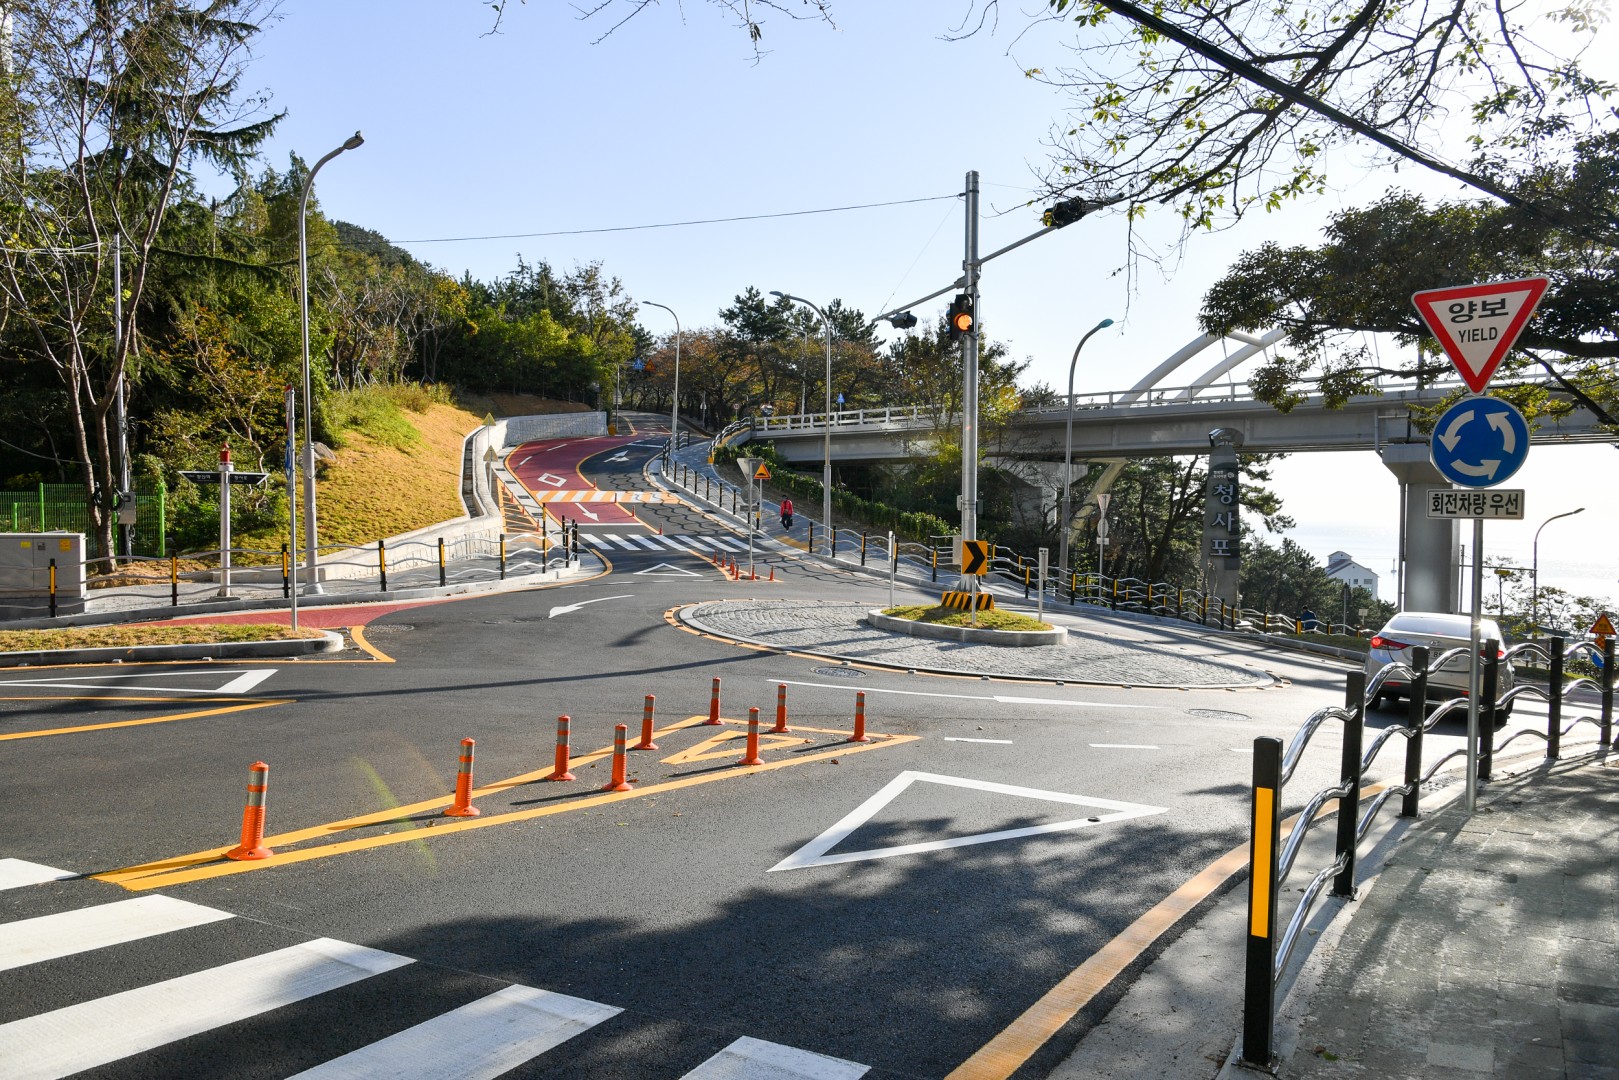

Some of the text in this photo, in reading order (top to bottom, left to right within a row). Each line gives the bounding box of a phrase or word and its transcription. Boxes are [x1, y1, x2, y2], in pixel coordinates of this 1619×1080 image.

[1448, 298, 1509, 323] 양보
[1458, 327, 1498, 343] YIELD
[1432, 493, 1519, 515] 회전차량 우선
[1210, 484, 1235, 556] 청사포
